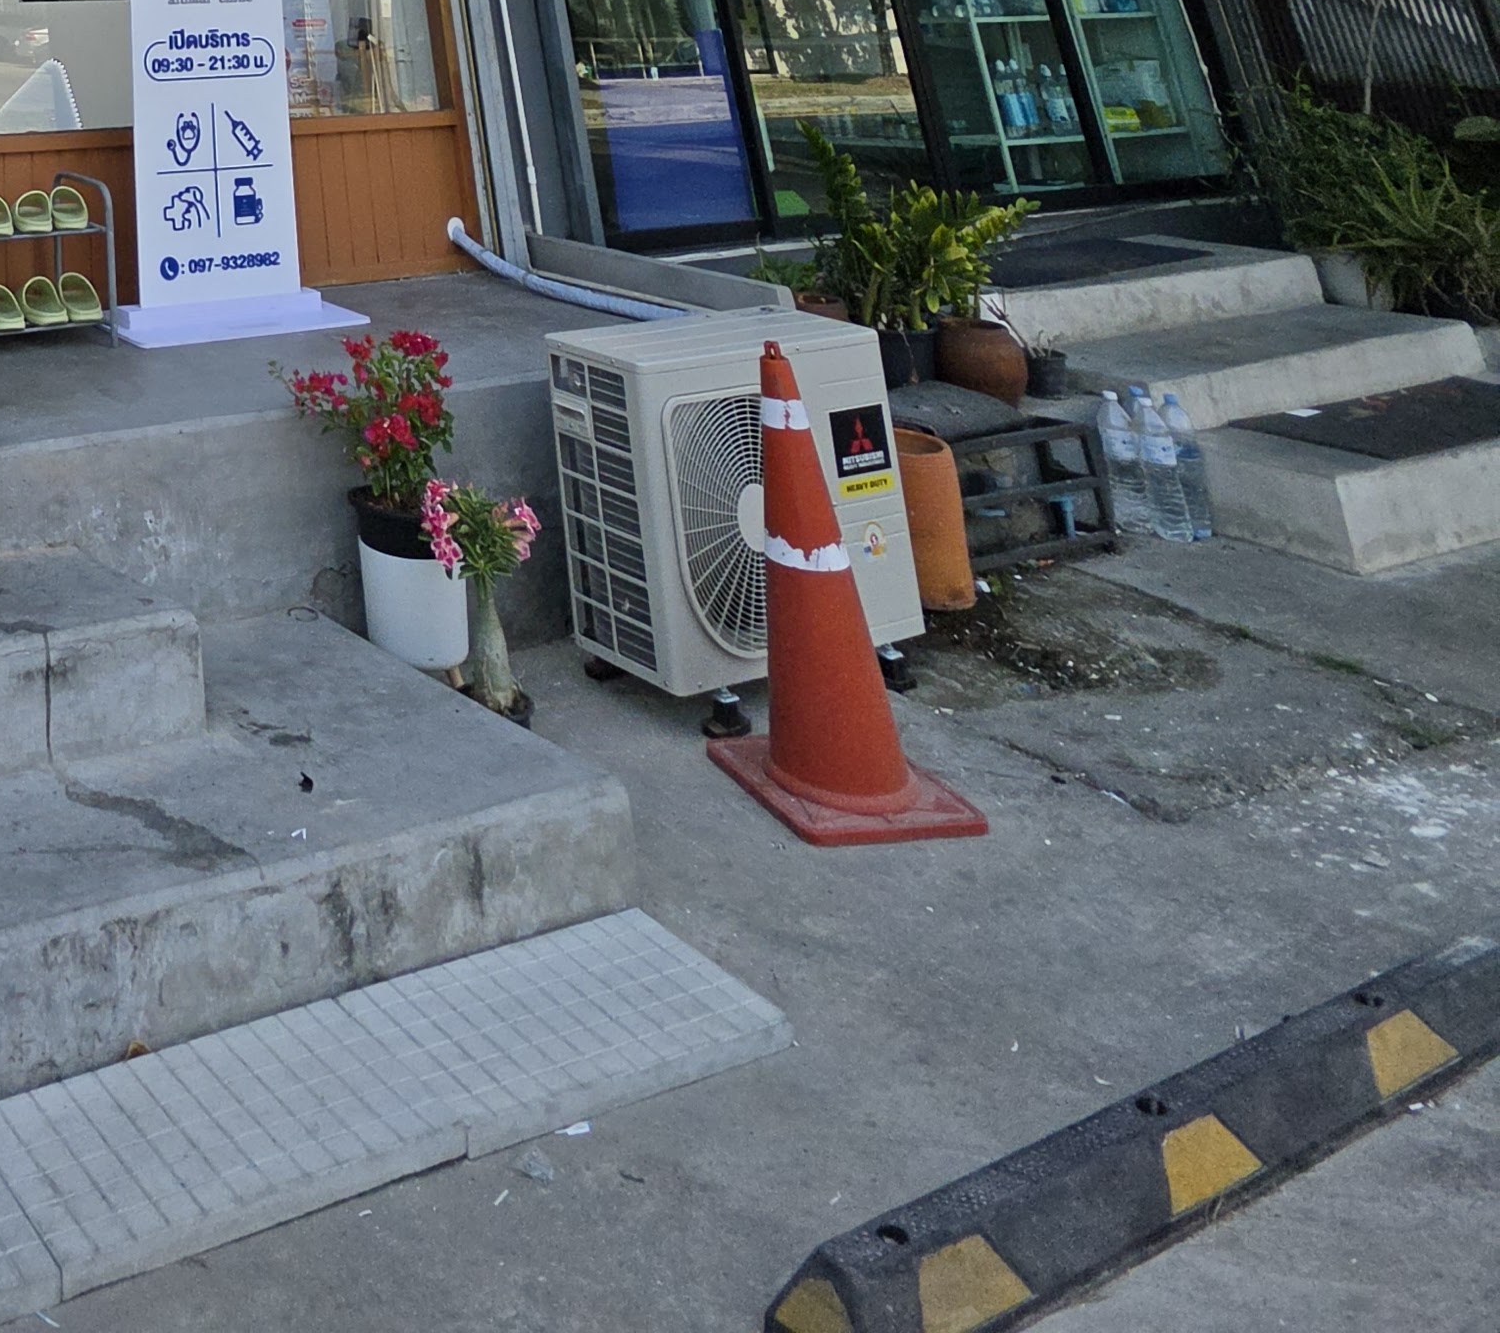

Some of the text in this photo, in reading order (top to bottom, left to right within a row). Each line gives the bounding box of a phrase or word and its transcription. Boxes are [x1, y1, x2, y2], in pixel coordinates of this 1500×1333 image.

[168, 28, 251, 51] เปิดบริการ
[151, 56, 194, 74] 09:30
[208, 54, 251, 71] 21:30
[253, 55, 269, 69] น.
[187, 251, 281, 274] 097-9328982
[846, 478, 889, 493] HEAVY DUTY
